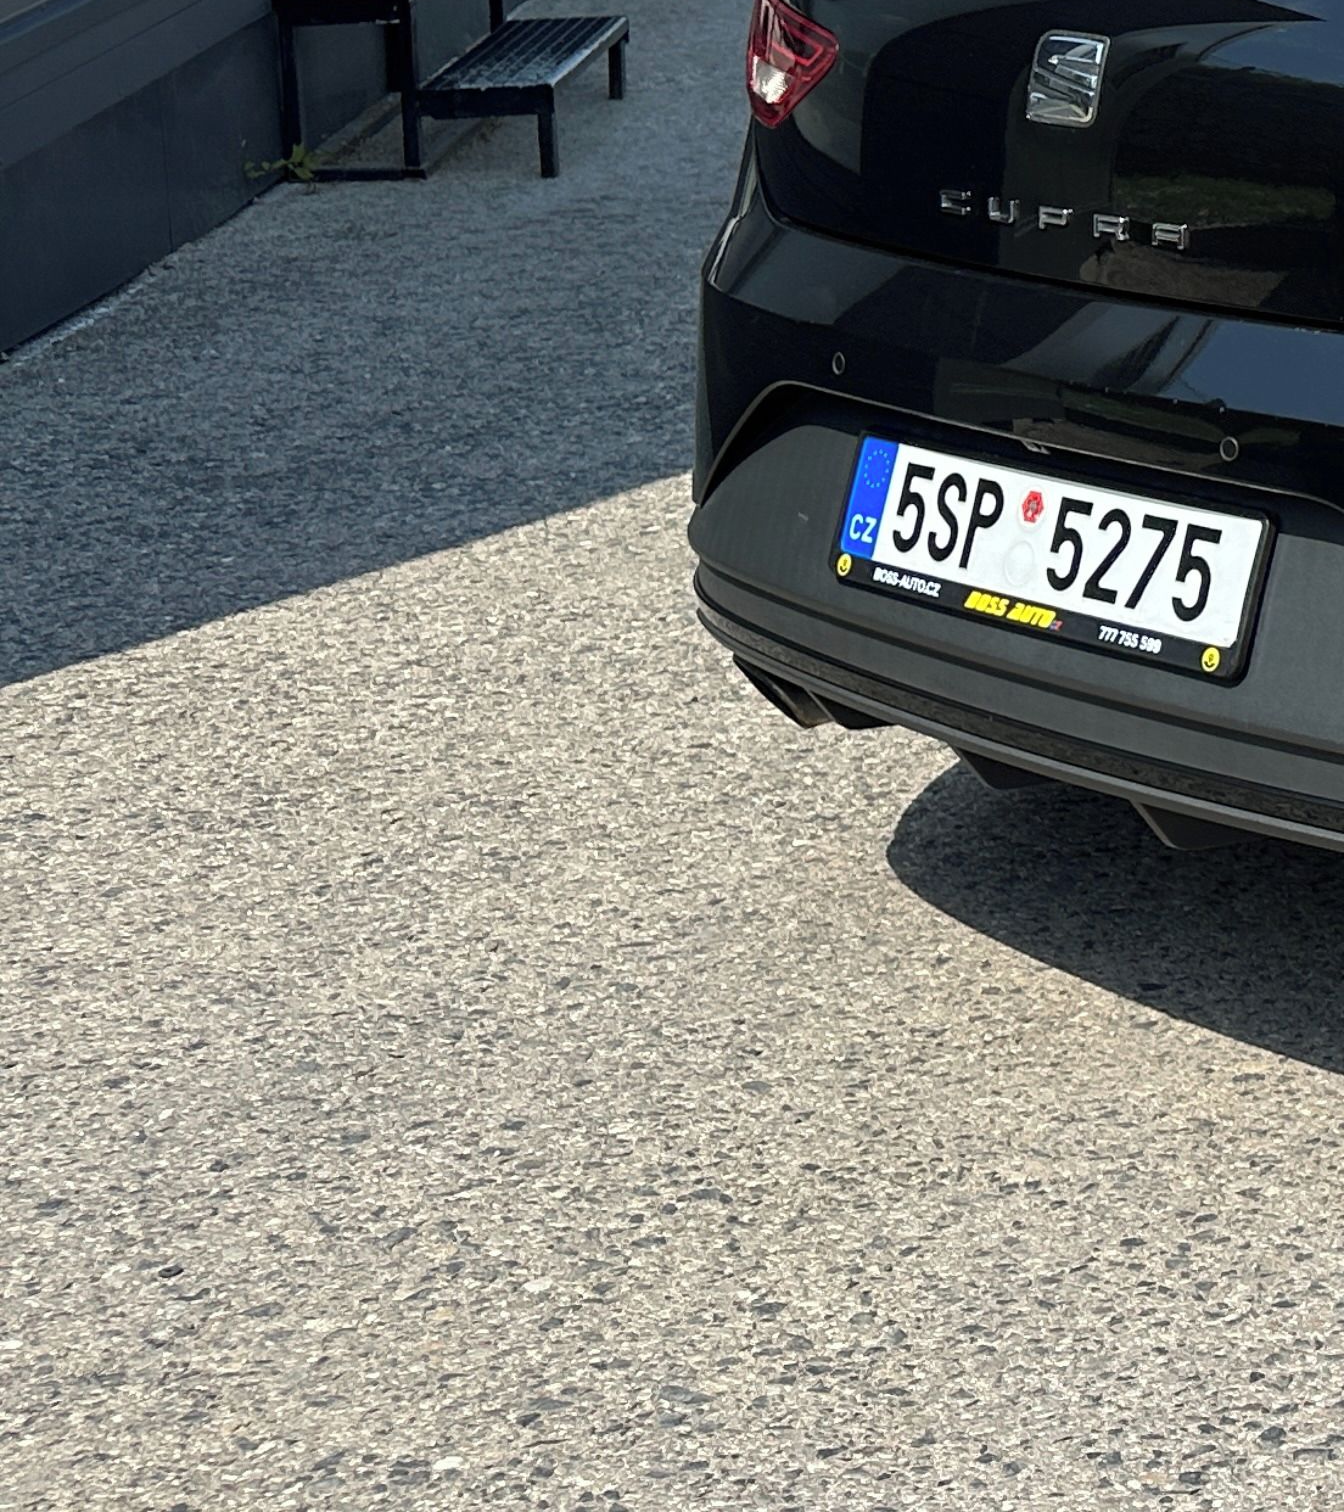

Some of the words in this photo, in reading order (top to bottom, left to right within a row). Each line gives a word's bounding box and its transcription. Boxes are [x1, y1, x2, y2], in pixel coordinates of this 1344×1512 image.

[939, 188, 1189, 251] CUPRA
[849, 513, 878, 544] CZ
[892, 462, 1004, 570] 5SP
[1046, 496, 1222, 622] 5275
[963, 591, 1010, 617] BOSS
[1098, 625, 1118, 642] 777
